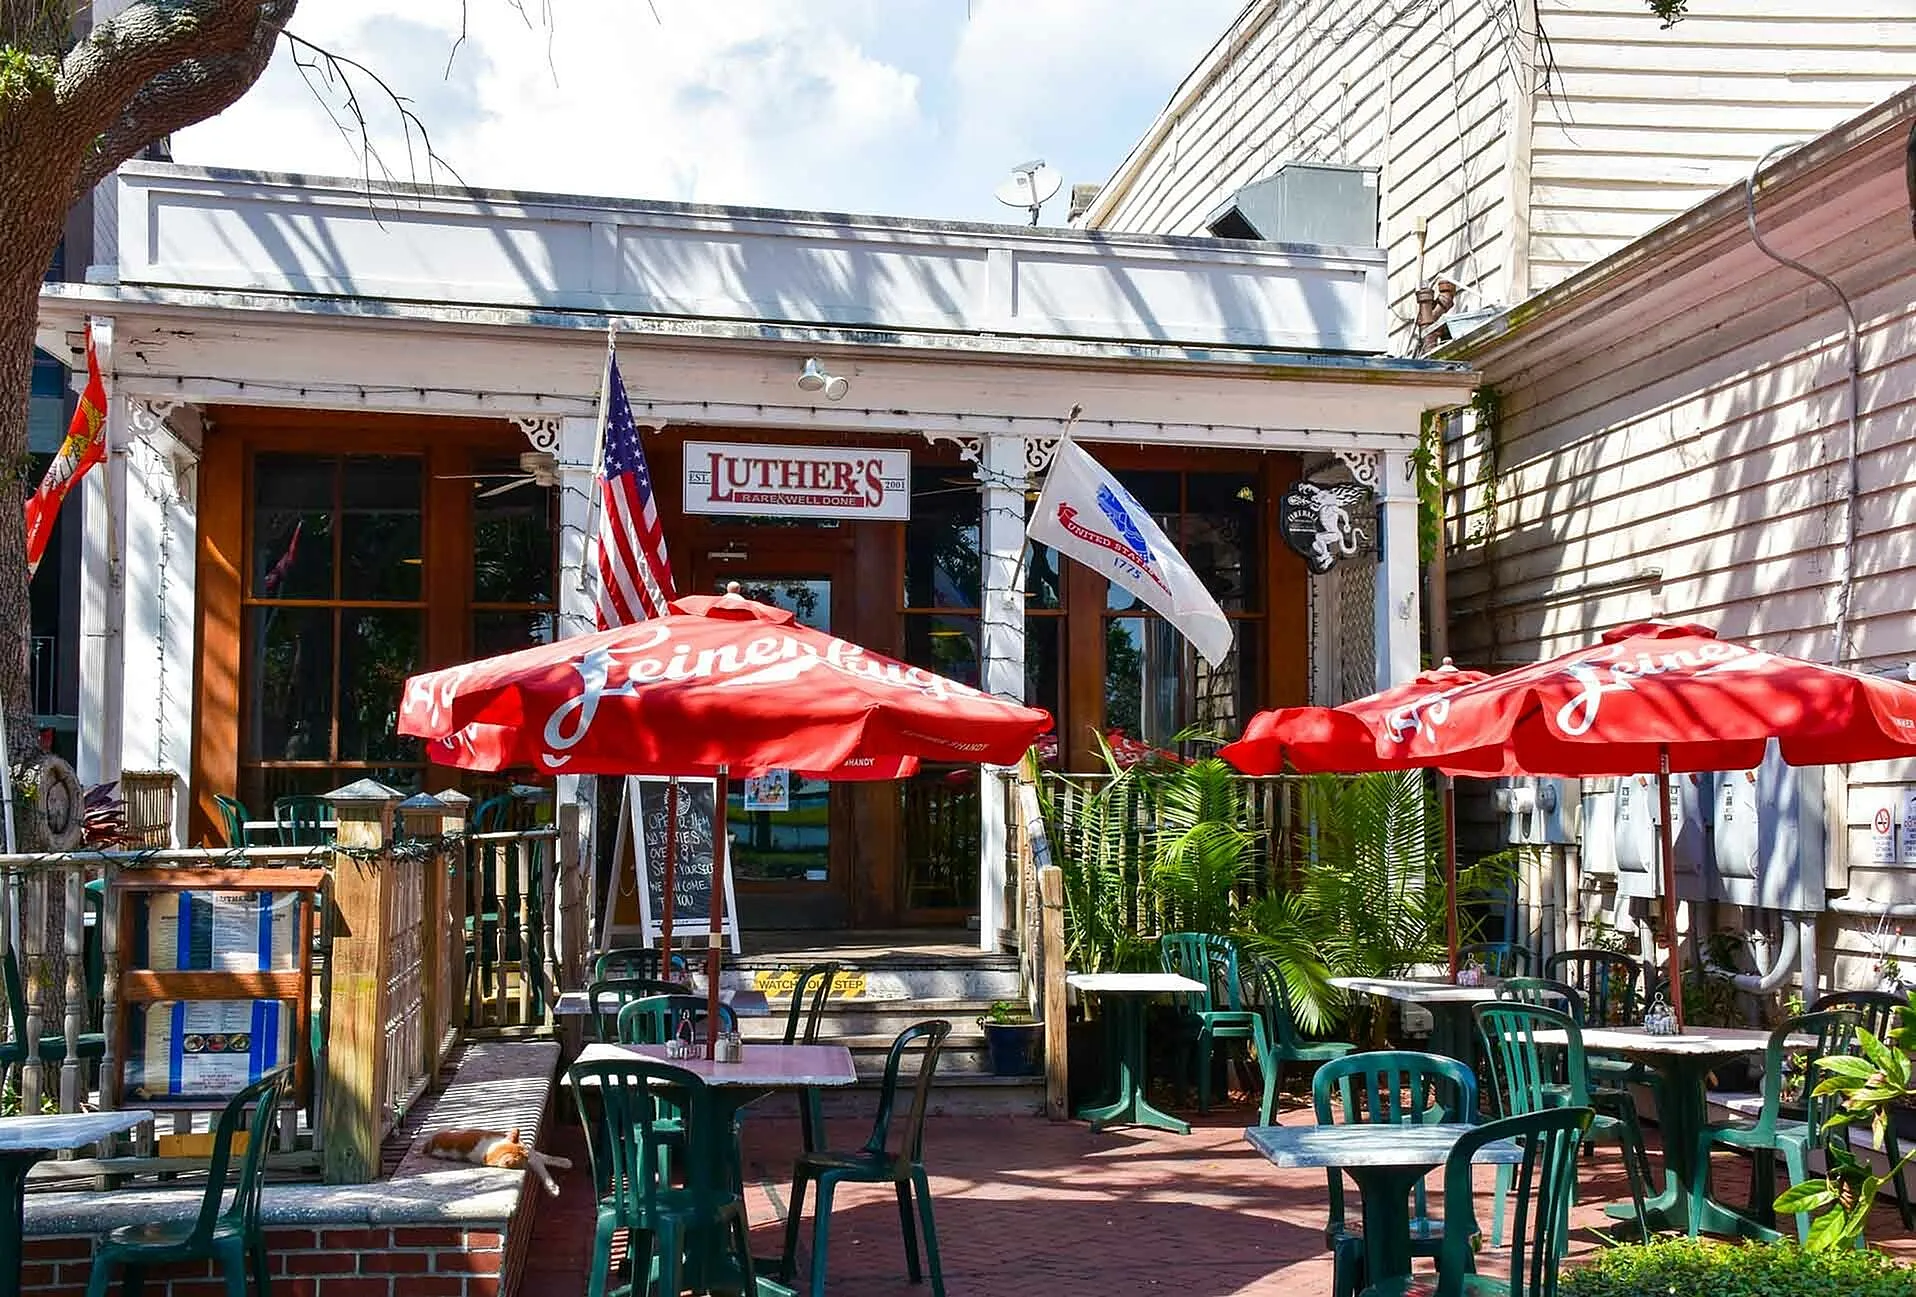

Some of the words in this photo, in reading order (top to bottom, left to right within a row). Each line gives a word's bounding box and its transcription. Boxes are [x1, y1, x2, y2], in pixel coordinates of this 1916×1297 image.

[688, 472, 709, 482] EST.
[885, 480, 905, 490] 2001
[1067, 522, 1112, 546] UNITED
[1113, 556, 1142, 580] 1775
[834, 980, 863, 990] STEP
